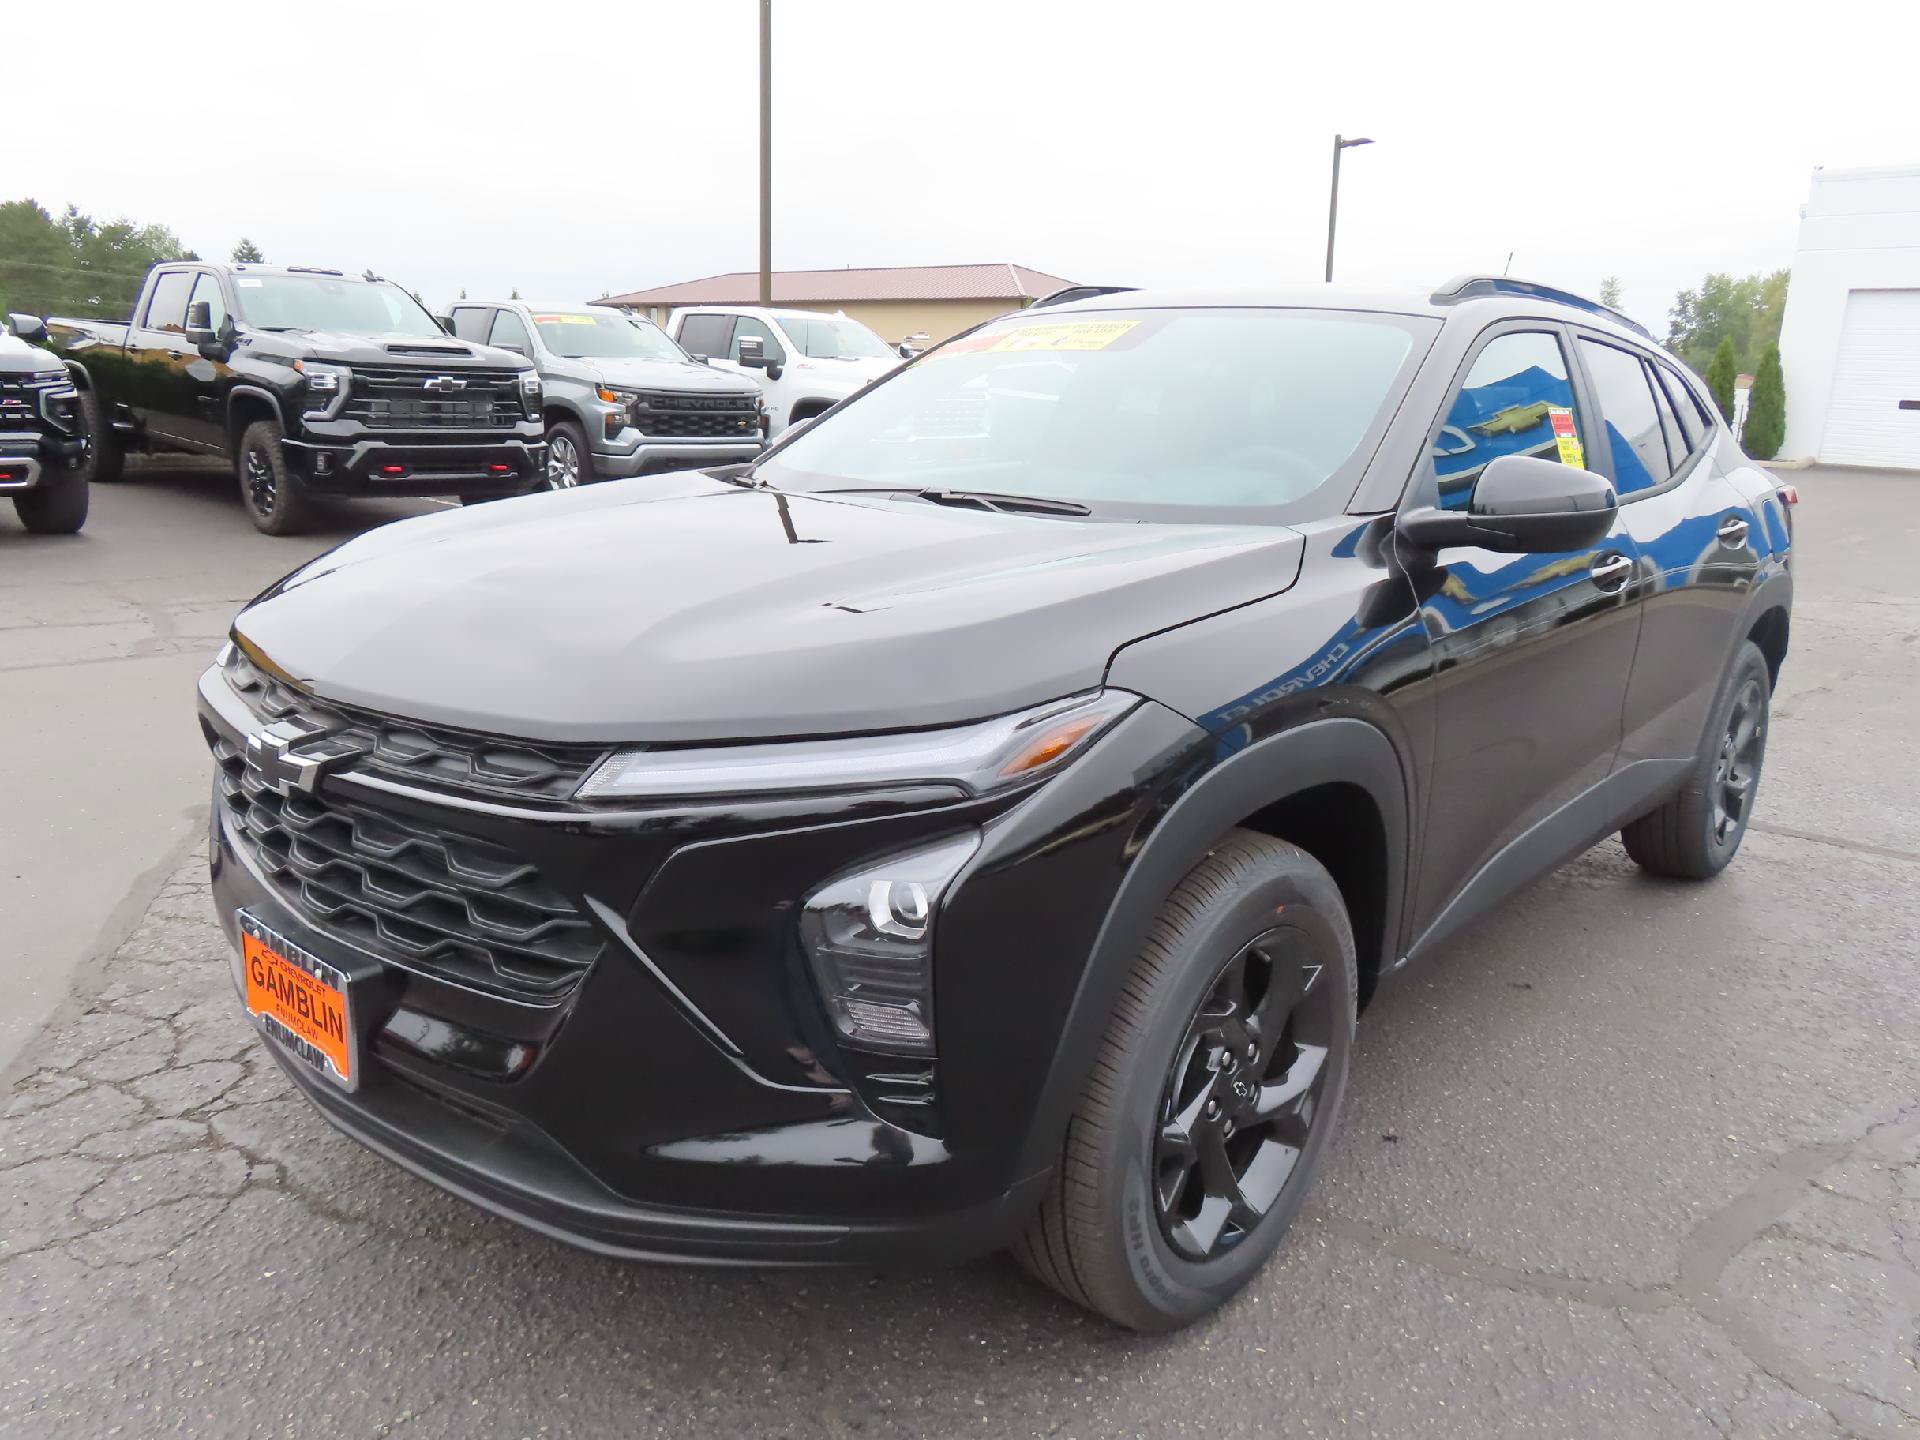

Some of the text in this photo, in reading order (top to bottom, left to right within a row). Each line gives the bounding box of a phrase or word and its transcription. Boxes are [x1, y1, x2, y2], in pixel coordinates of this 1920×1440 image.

[650, 397, 753, 409] CHEVROLET
[280, 961, 326, 996] CHEVROLET
[251, 956, 344, 1044] GAMBLIN
[276, 1003, 319, 1040] ENUMCLAW
[265, 1014, 325, 1071] ENUMCLAW
